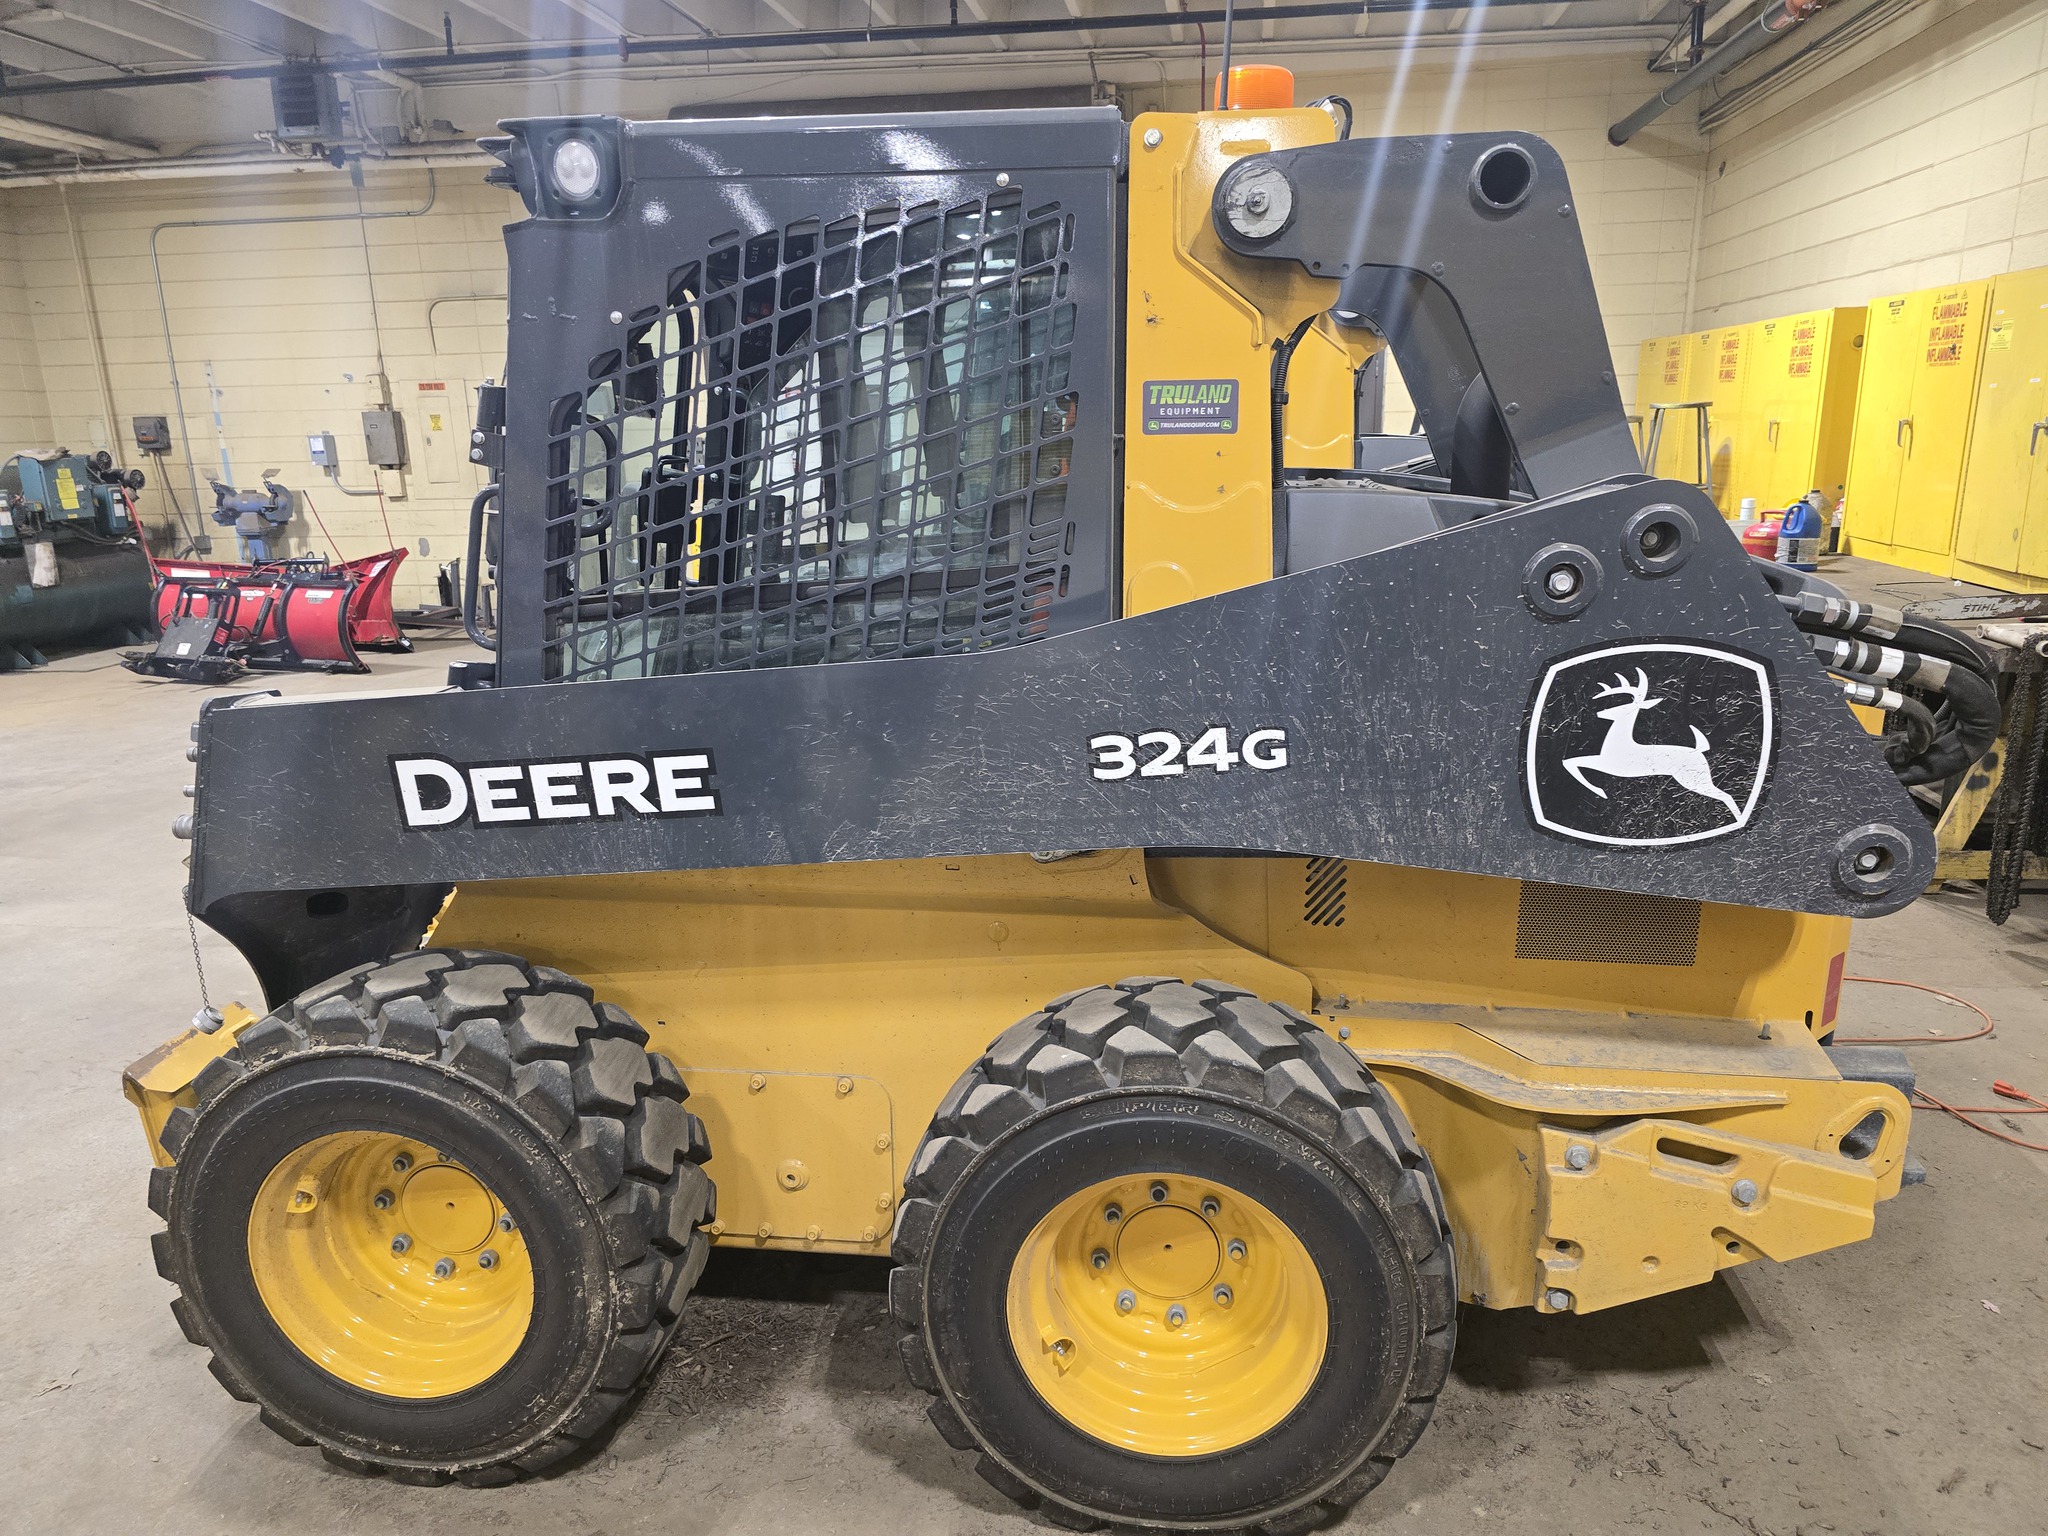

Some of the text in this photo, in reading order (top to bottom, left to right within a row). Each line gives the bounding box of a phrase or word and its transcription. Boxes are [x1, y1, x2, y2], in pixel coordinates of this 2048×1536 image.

[1932, 302, 1968, 320] FLAMMABLE
[1149, 384, 1232, 405] TRULAND
[1159, 407, 1221, 416] EQUIPMENT
[1159, 421, 1221, 429] TRULANDEQUIP.COM
[1961, 603, 1999, 613] STIHL
[1090, 727, 1288, 780] 324G
[394, 754, 716, 827] DEERE
[1080, 1101, 1200, 1120] SUPER
[1213, 1110, 1362, 1213] SIDEWALL
